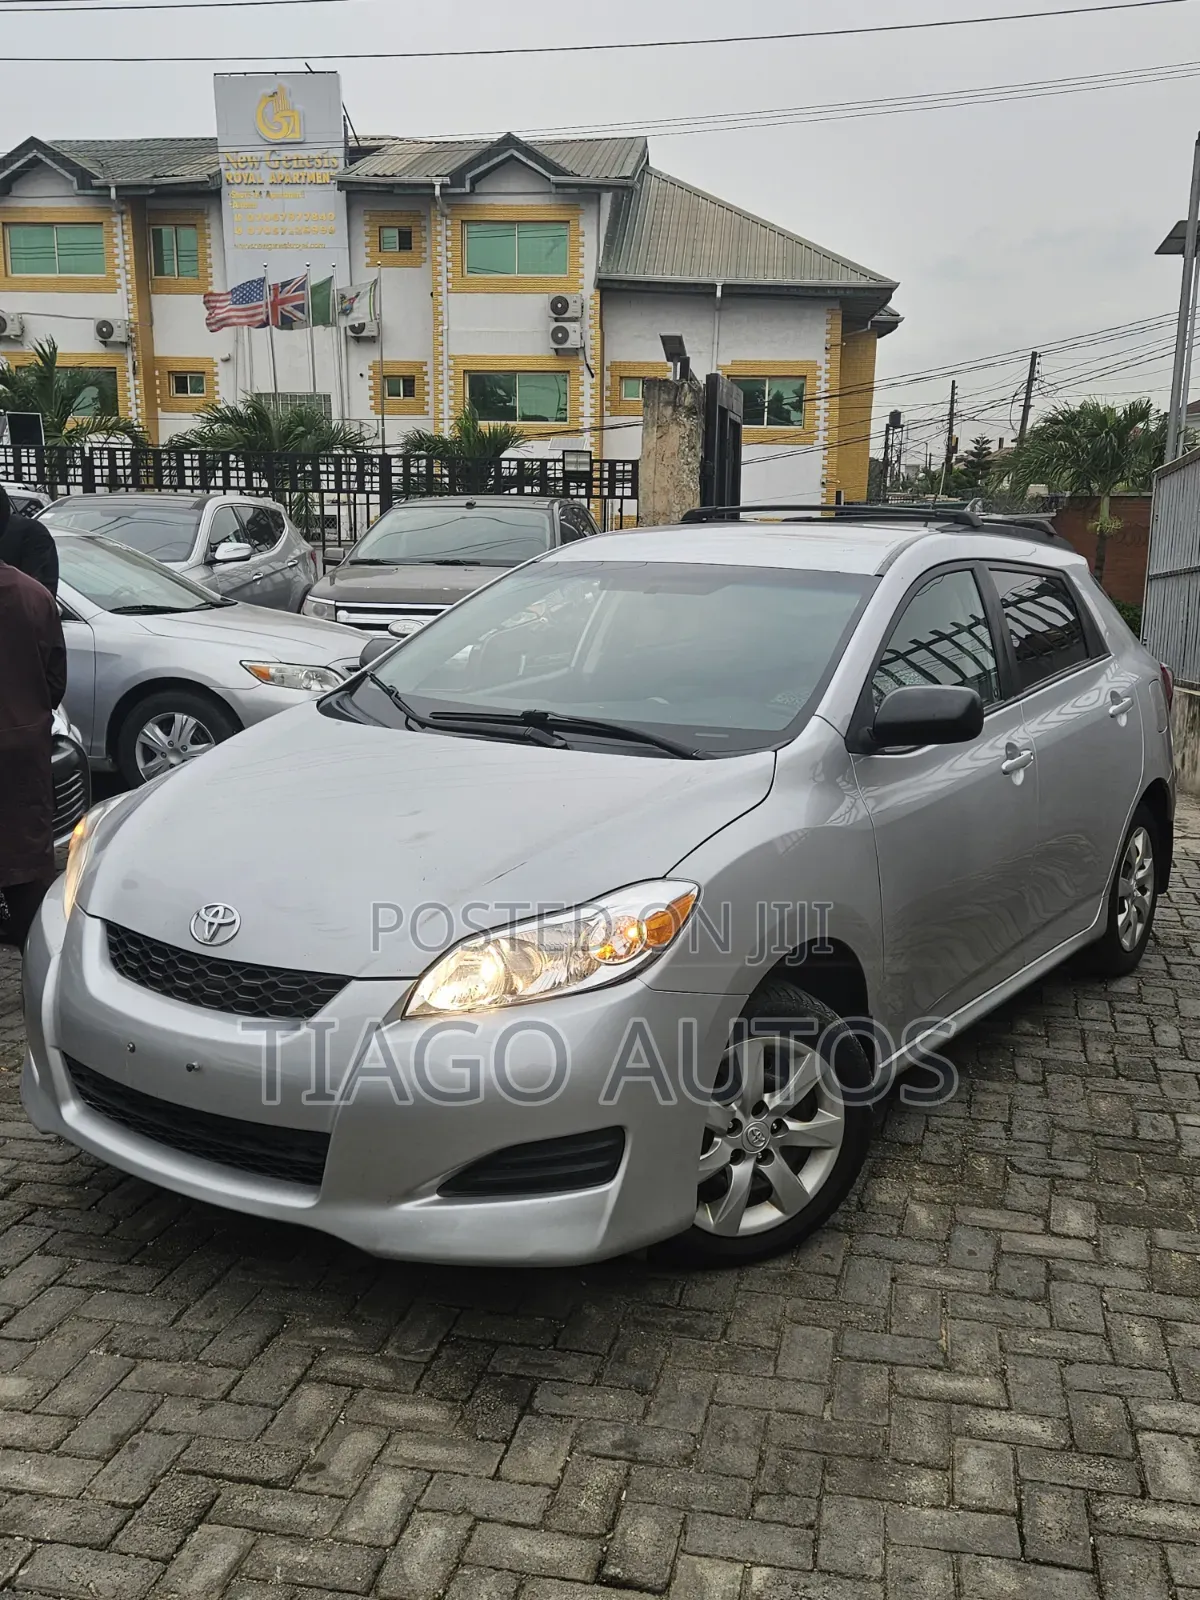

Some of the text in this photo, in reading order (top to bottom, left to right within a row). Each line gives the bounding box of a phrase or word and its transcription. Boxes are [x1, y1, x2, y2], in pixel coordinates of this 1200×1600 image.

[224, 150, 339, 170] New Genesis
[225, 172, 264, 185] ROYAL
